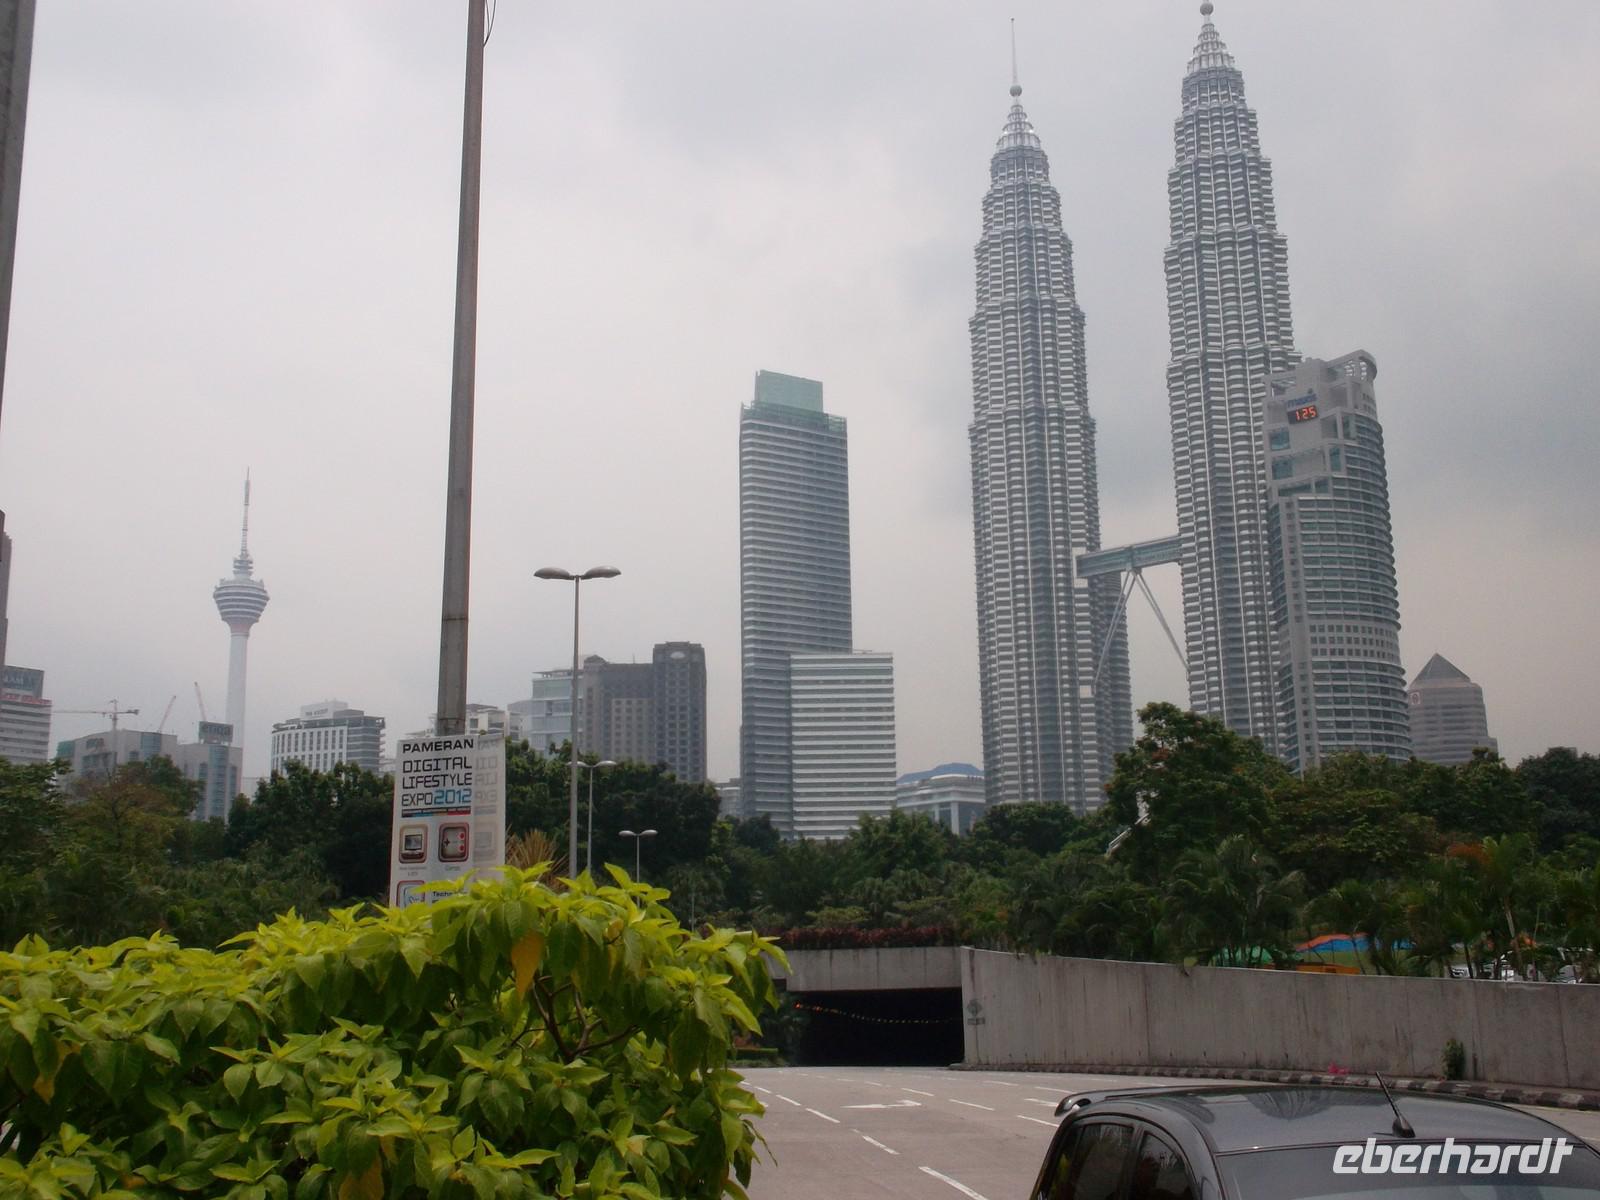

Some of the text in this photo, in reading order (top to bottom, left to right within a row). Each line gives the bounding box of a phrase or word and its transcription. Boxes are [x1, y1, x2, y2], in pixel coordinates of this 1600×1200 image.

[402, 738, 474, 754] PAMERAN
[402, 756, 473, 774] DIGITAL
[402, 772, 473, 789] LIFESTYLE
